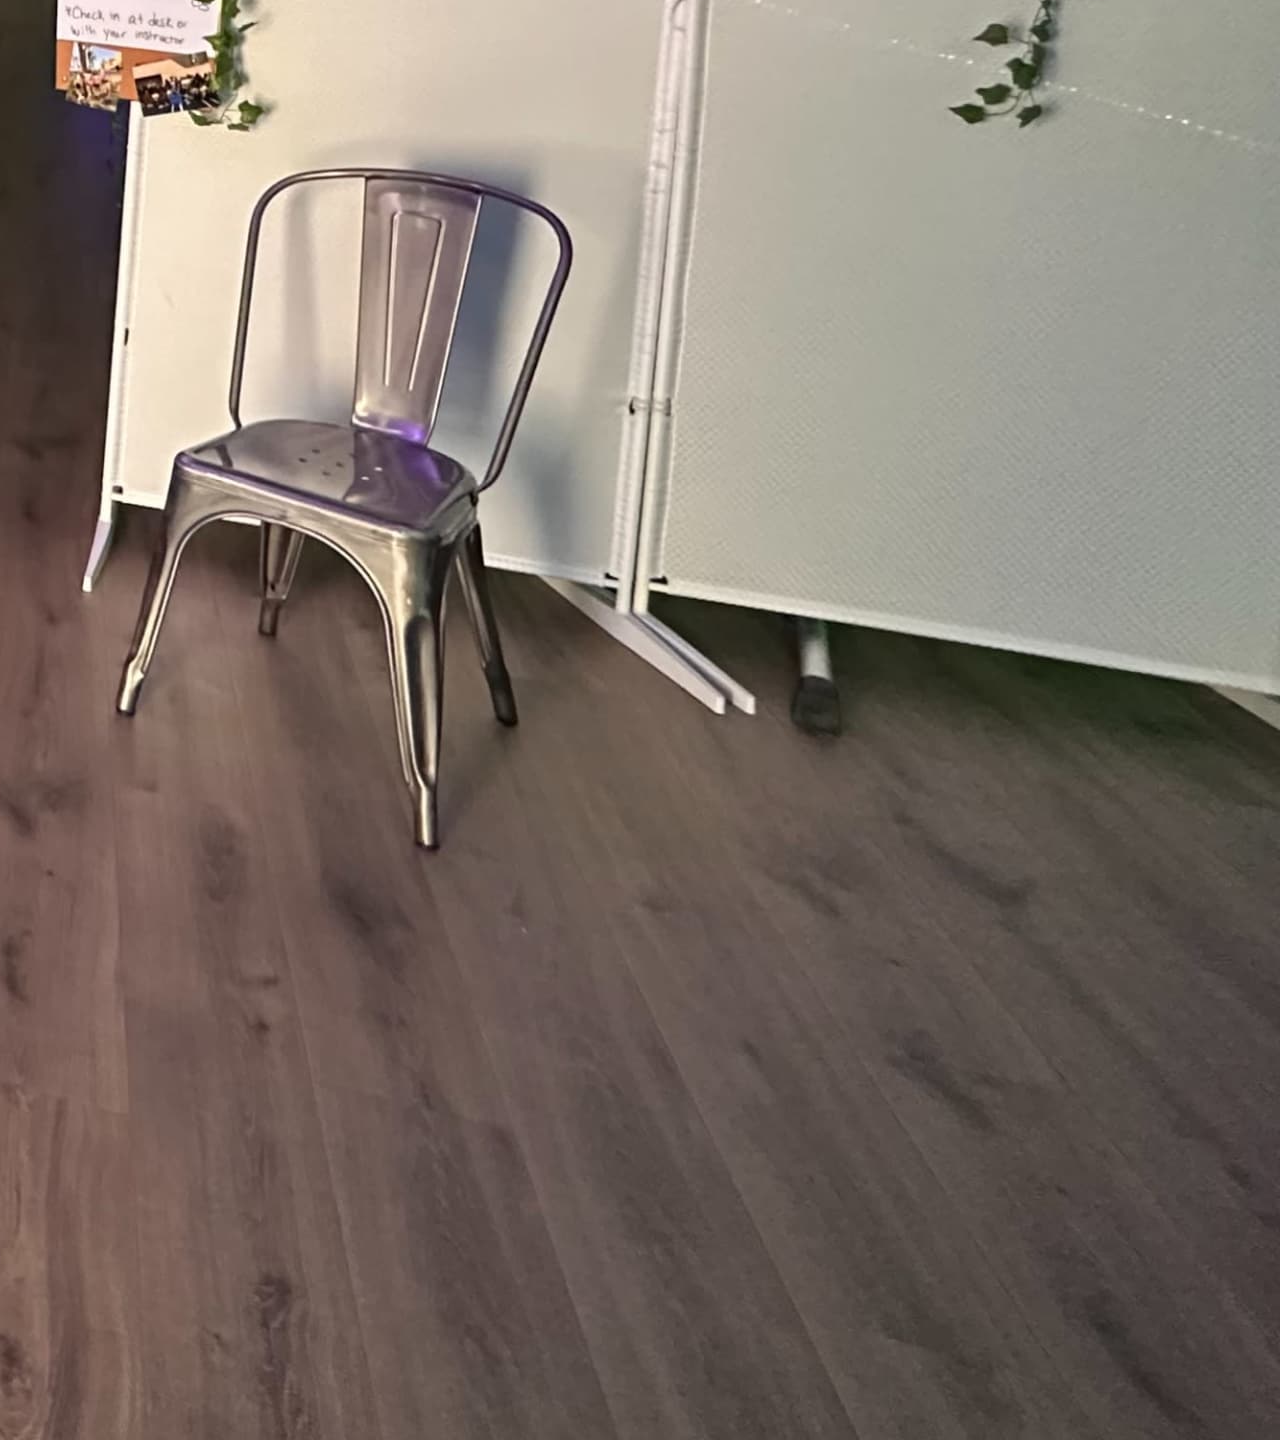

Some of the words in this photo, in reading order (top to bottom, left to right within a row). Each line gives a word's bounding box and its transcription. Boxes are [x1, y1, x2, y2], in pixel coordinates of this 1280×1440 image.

[109, 11, 121, 22] in
[128, 13, 144, 26] at
[148, 12, 174, 29] desk
[134, 29, 185, 45] instructor
